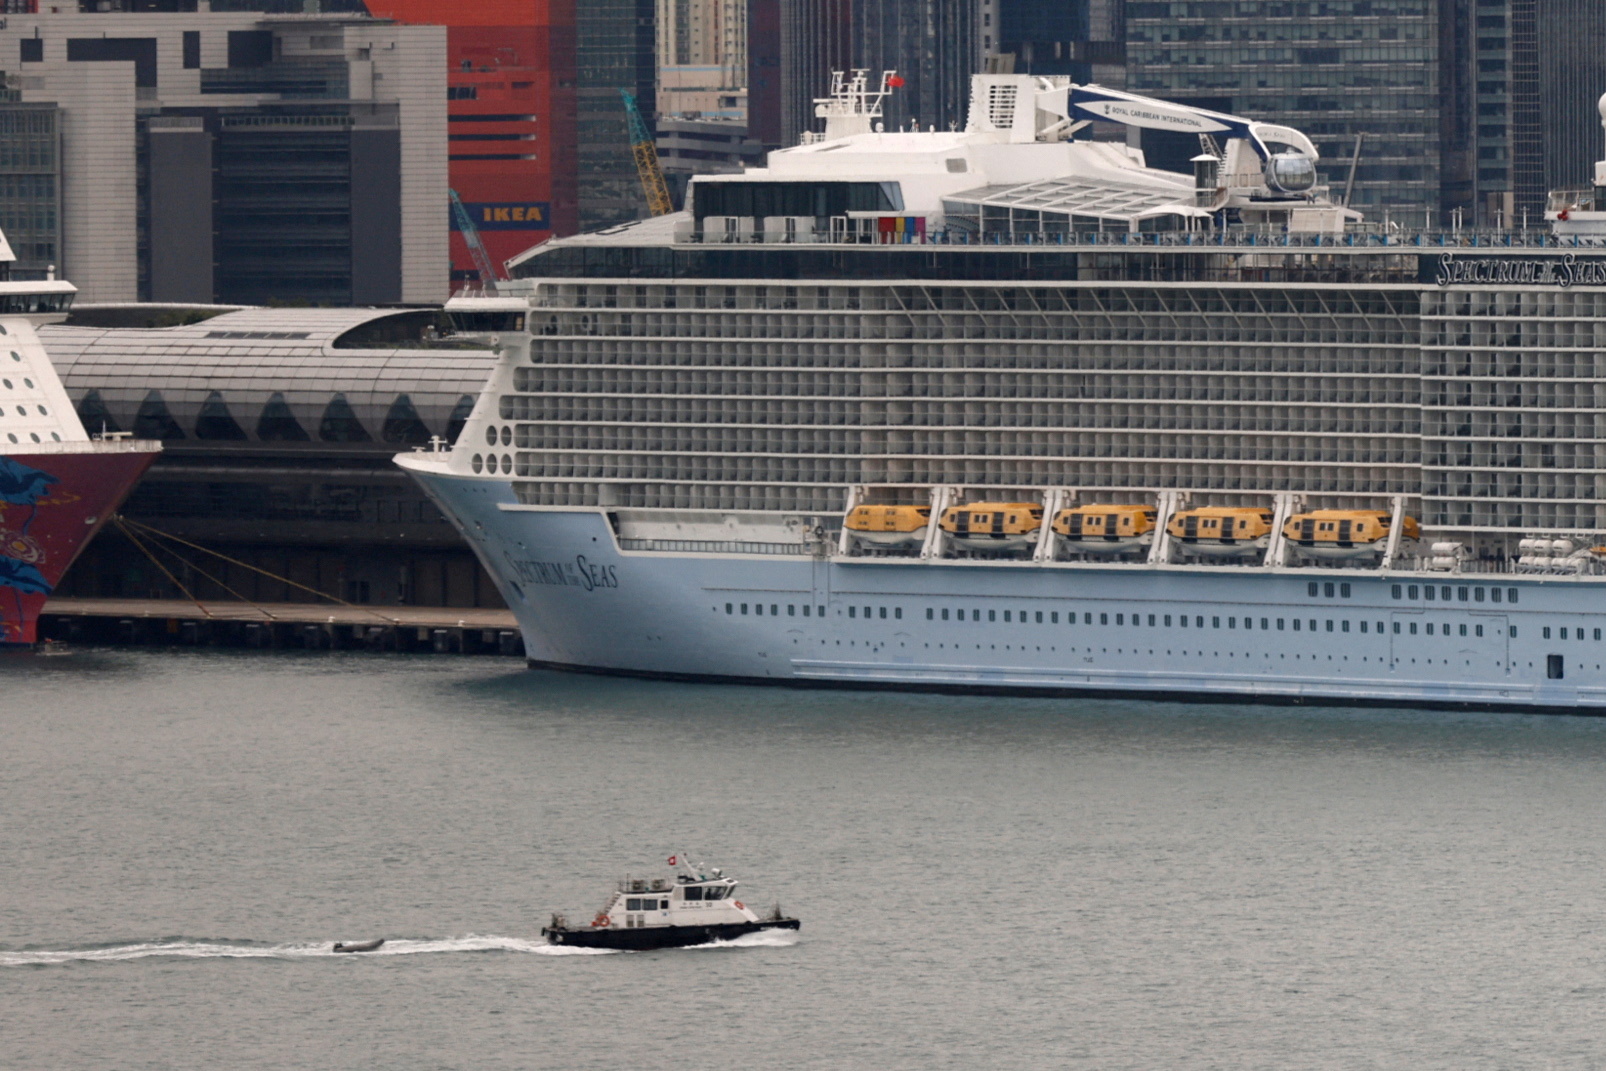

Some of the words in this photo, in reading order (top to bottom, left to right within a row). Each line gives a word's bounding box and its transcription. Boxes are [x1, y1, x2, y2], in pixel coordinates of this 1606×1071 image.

[1112, 107, 1128, 116] ROYAL
[1130, 110, 1160, 120] CARIBBEAN
[1161, 114, 1202, 127] INTERNATIONAL
[483, 207, 542, 222] IKEA
[1437, 252, 1537, 287] SPECTRUM
[577, 554, 618, 592] SEAS
